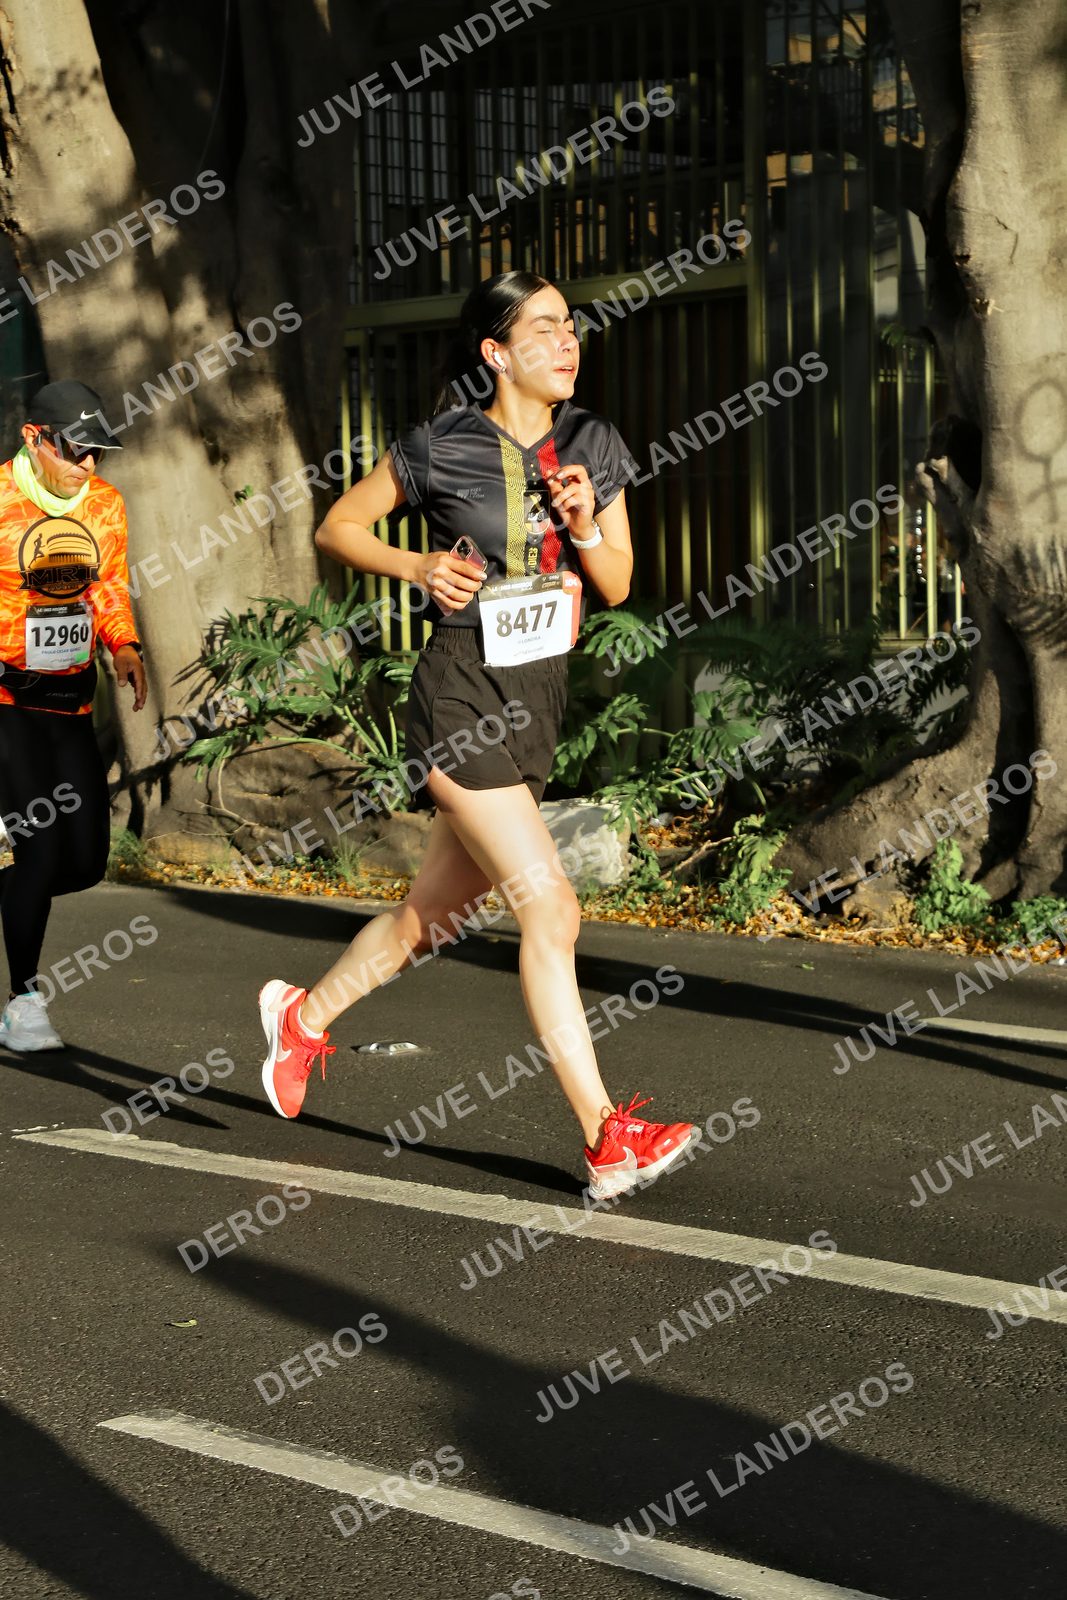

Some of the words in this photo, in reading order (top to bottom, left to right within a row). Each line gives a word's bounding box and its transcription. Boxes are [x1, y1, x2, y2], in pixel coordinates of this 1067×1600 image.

[27, 563, 101, 587] MRT
[496, 601, 557, 638] 8477
[31, 622, 89, 648] 12960
